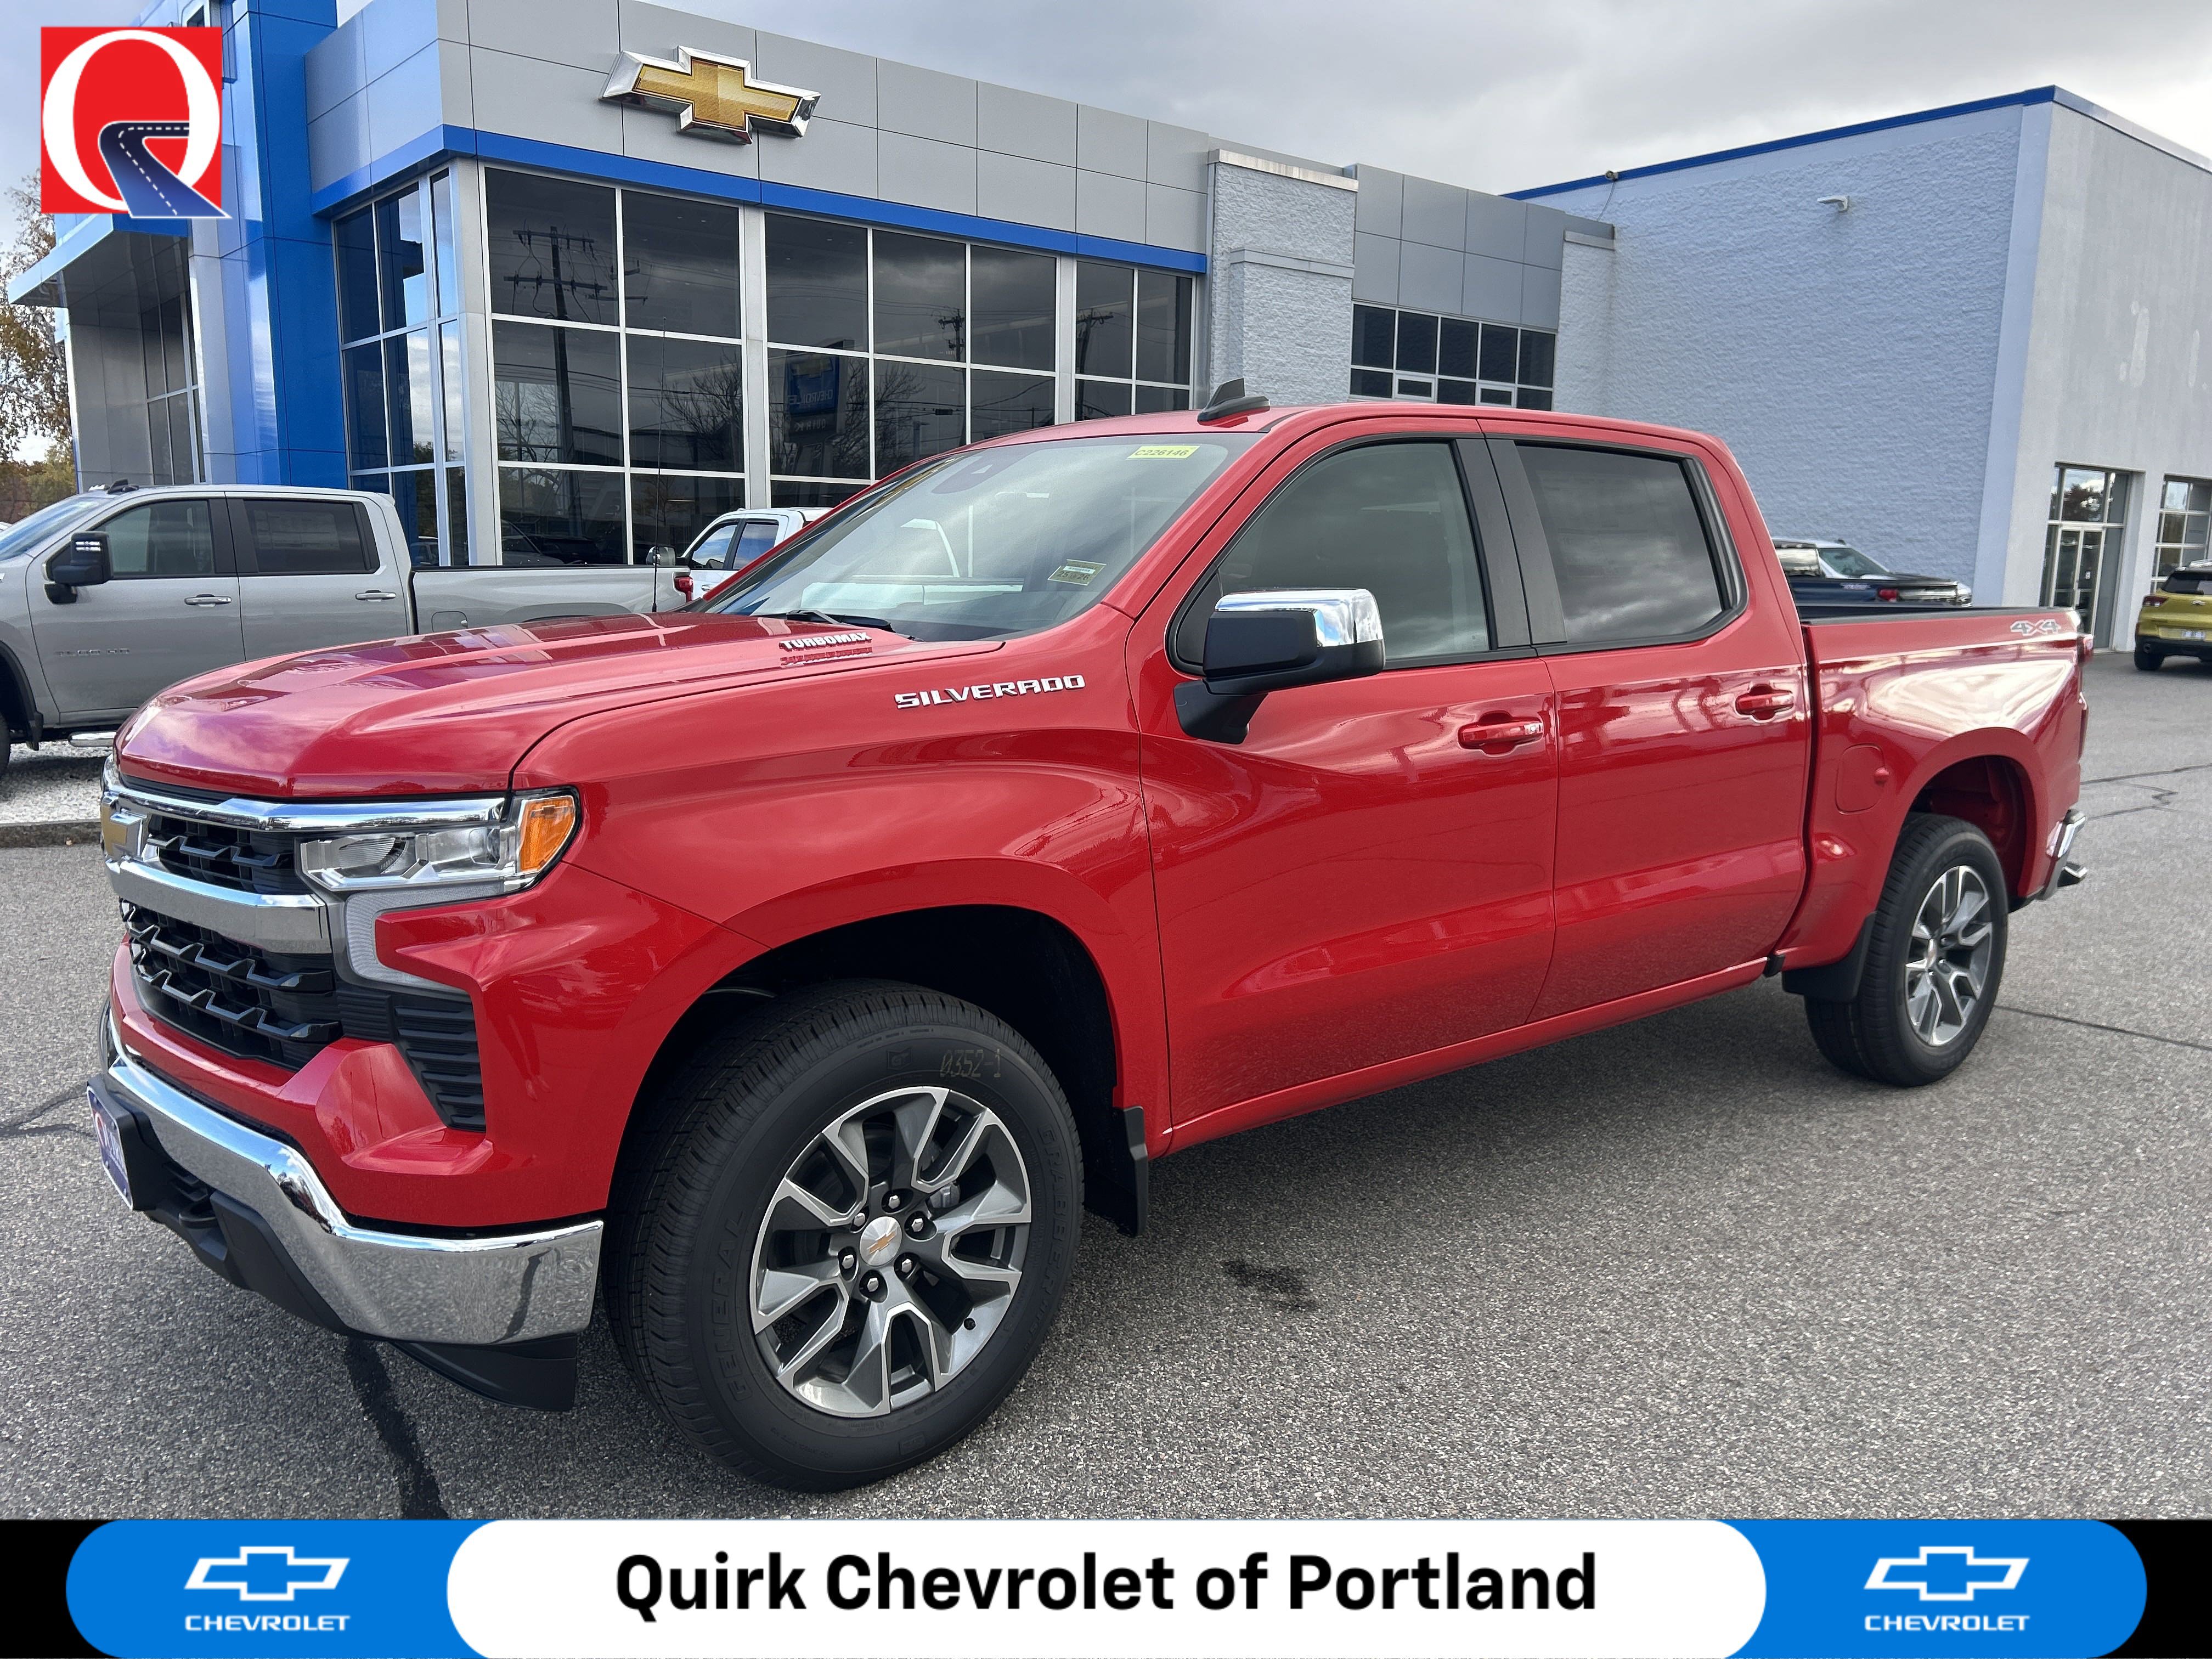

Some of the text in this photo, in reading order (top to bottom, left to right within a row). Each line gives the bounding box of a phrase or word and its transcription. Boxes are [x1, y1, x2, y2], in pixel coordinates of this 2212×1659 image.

[779, 632, 872, 652] TURBOMAX
[894, 675, 1086, 709] SILVERADO
[1038, 1122, 1068, 1296] GRABBER
[712, 1210, 754, 1401] GENERAL
